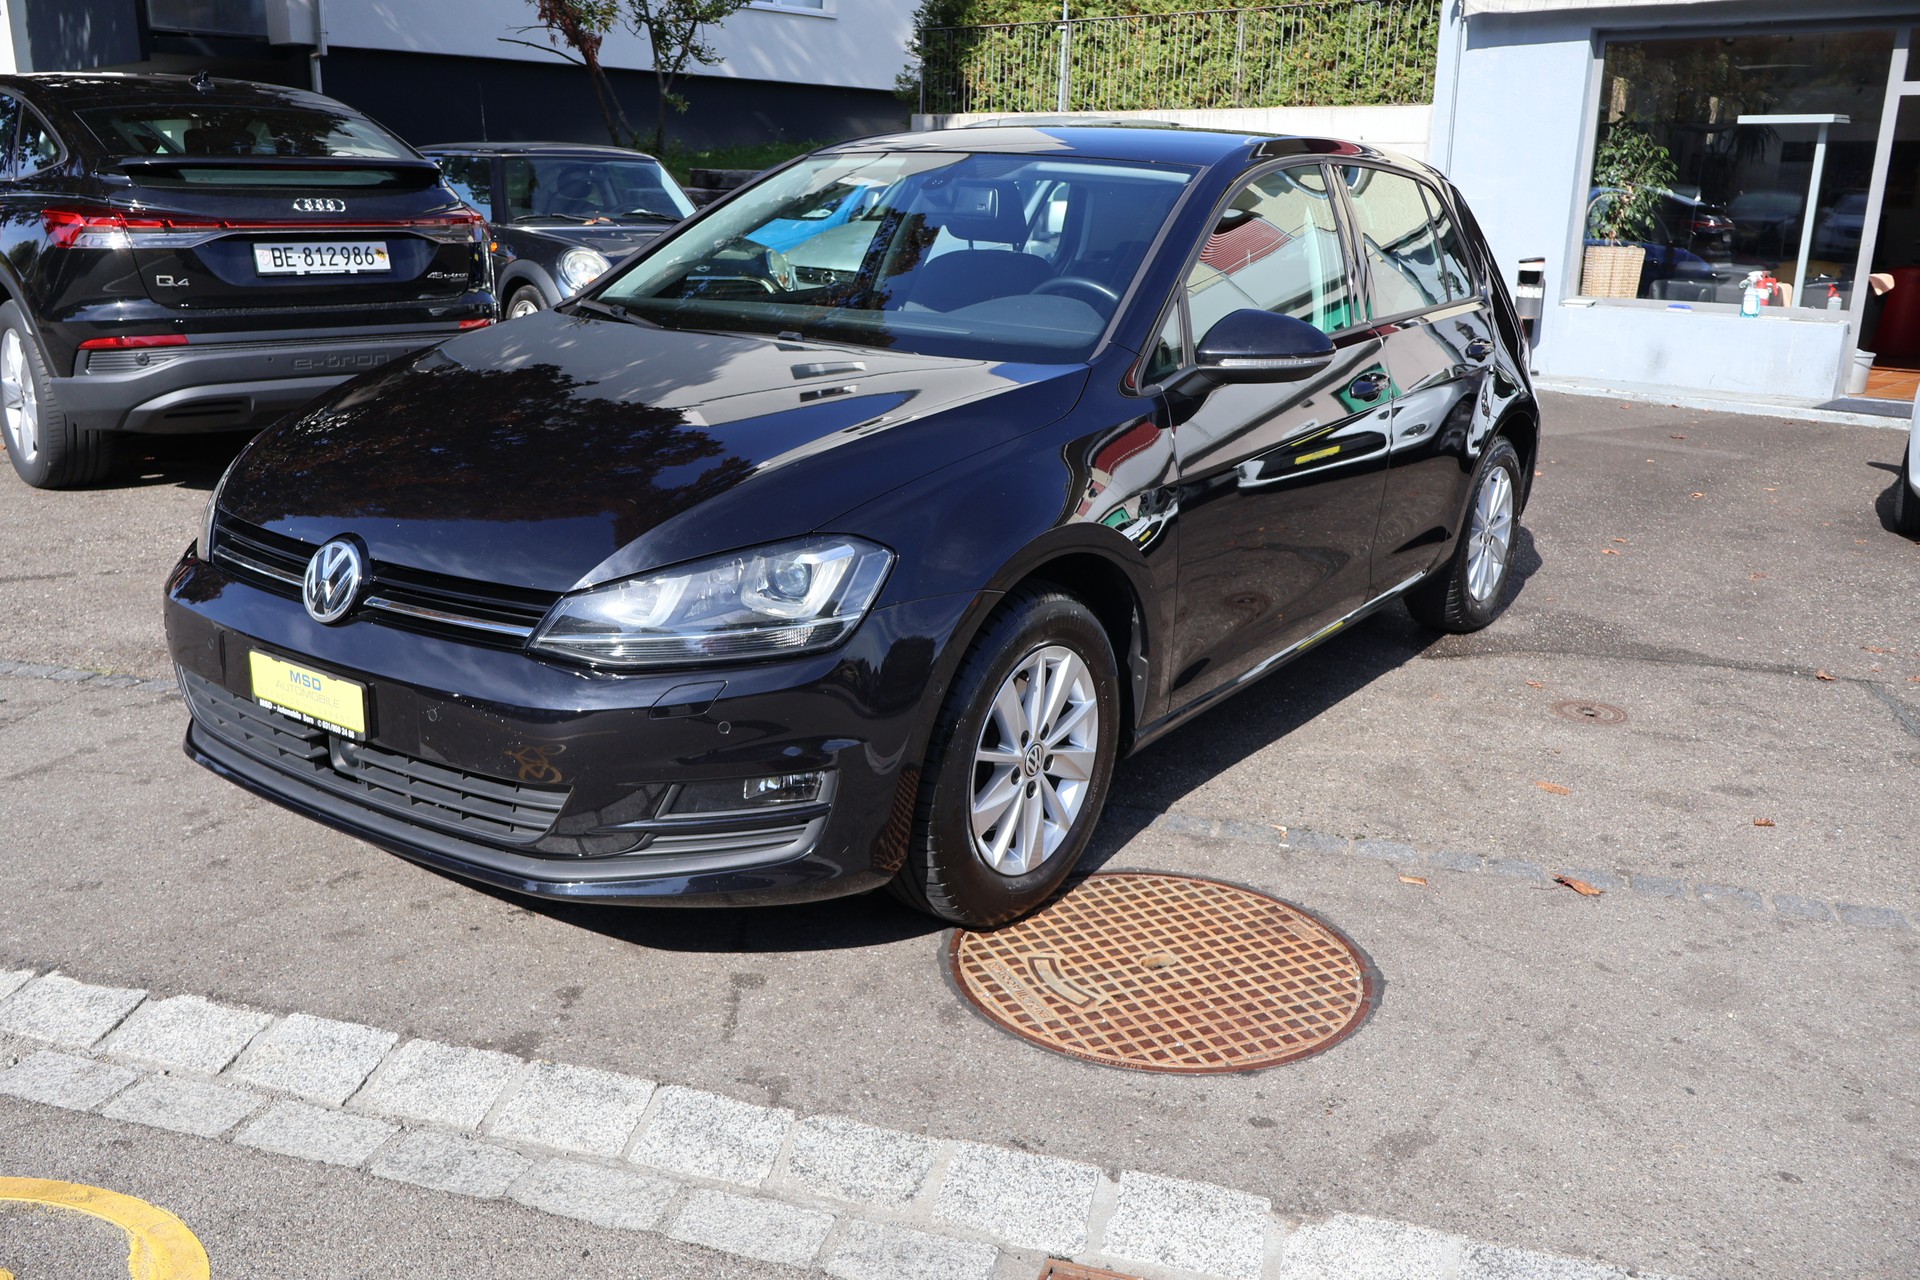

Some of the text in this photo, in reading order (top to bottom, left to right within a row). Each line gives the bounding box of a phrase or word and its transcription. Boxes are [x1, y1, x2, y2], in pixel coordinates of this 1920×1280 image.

[156, 275, 190, 287] Q4
[294, 353, 390, 370] e-tron
[289, 670, 322, 691] MSD
[276, 680, 340, 708] AUTOMOBILE
